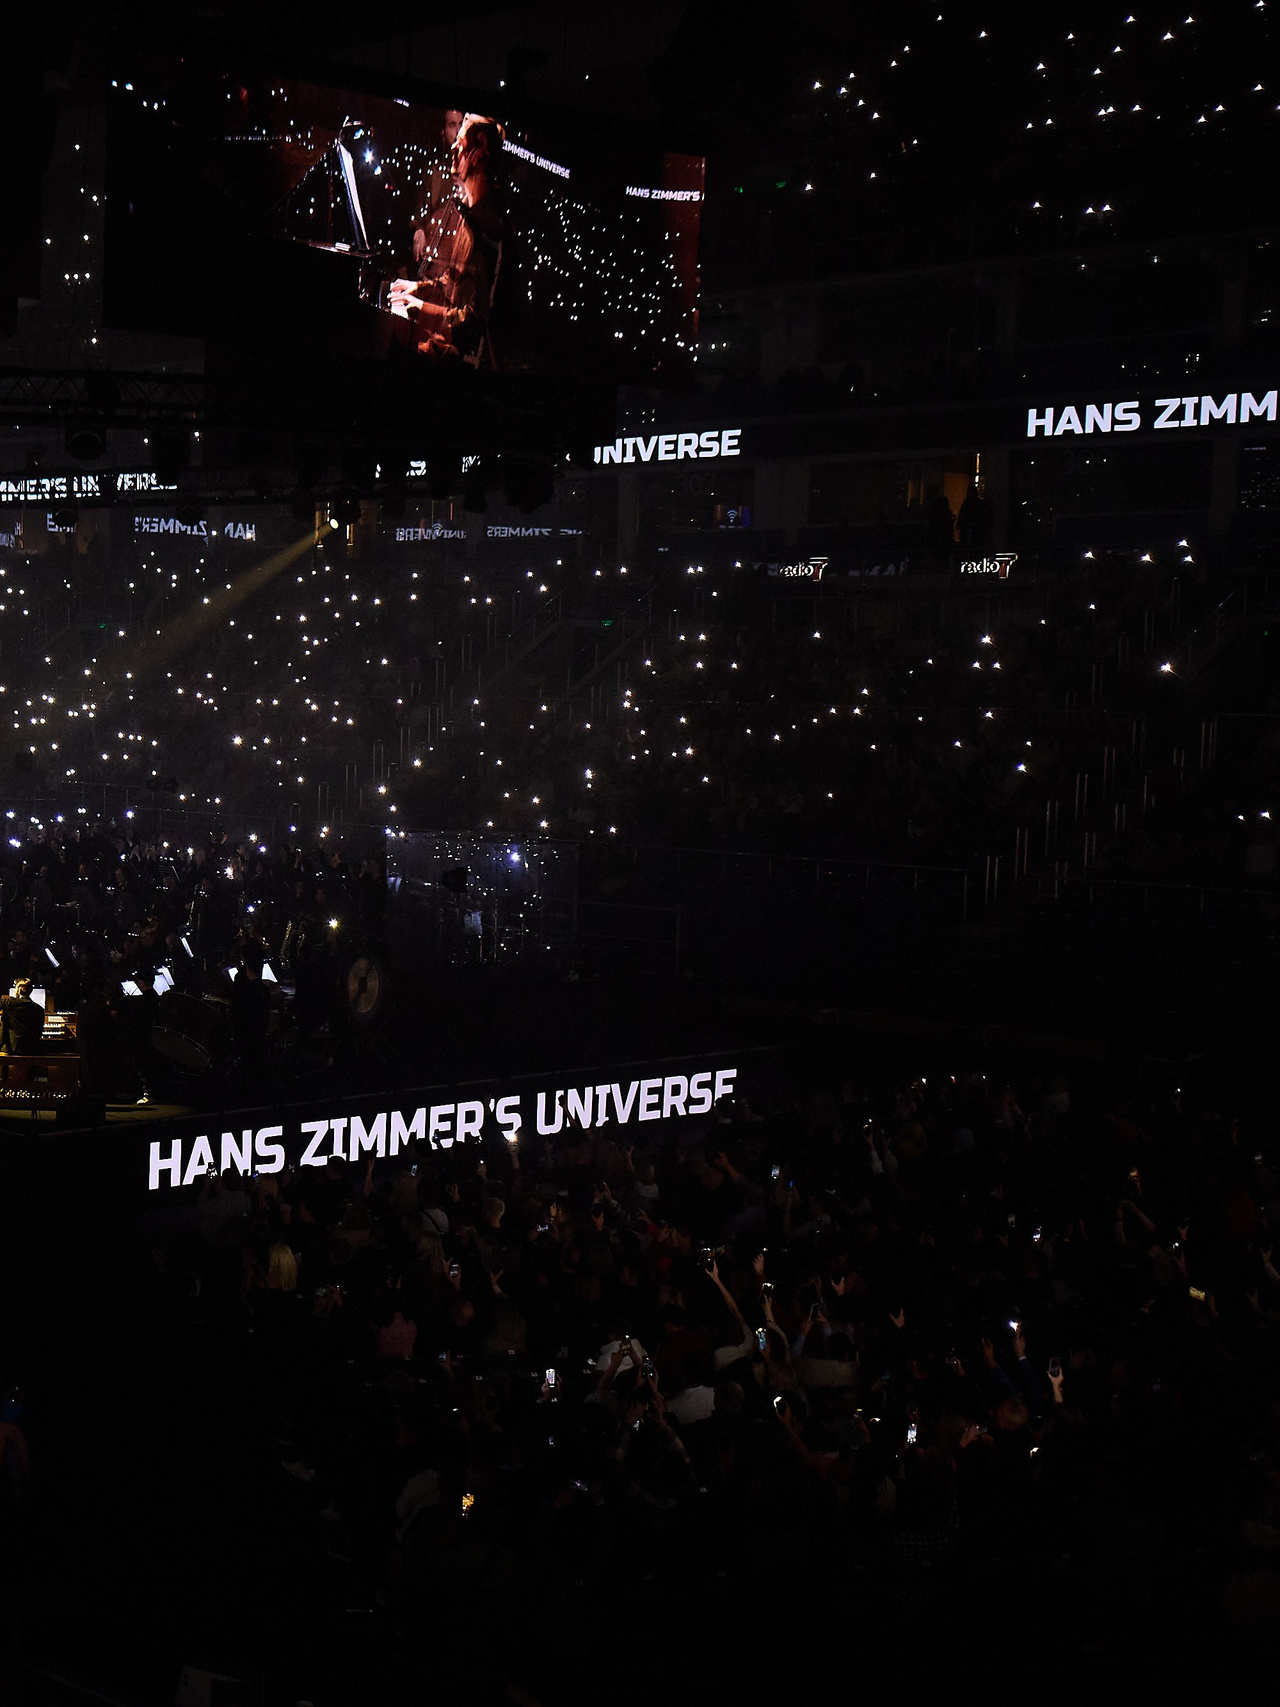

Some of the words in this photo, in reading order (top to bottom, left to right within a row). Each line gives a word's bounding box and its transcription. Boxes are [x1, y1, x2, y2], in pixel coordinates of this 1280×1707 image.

[536, 155, 571, 179] UNIVERSE
[625, 185, 650, 199] HANS
[651, 188, 701, 202] ZIMMER'S
[1026, 400, 1141, 438] HANS
[1153, 390, 1278, 429] ZIMM
[148, 1125, 286, 1191] HANS
[299, 1095, 522, 1167] ZIMMER'S
